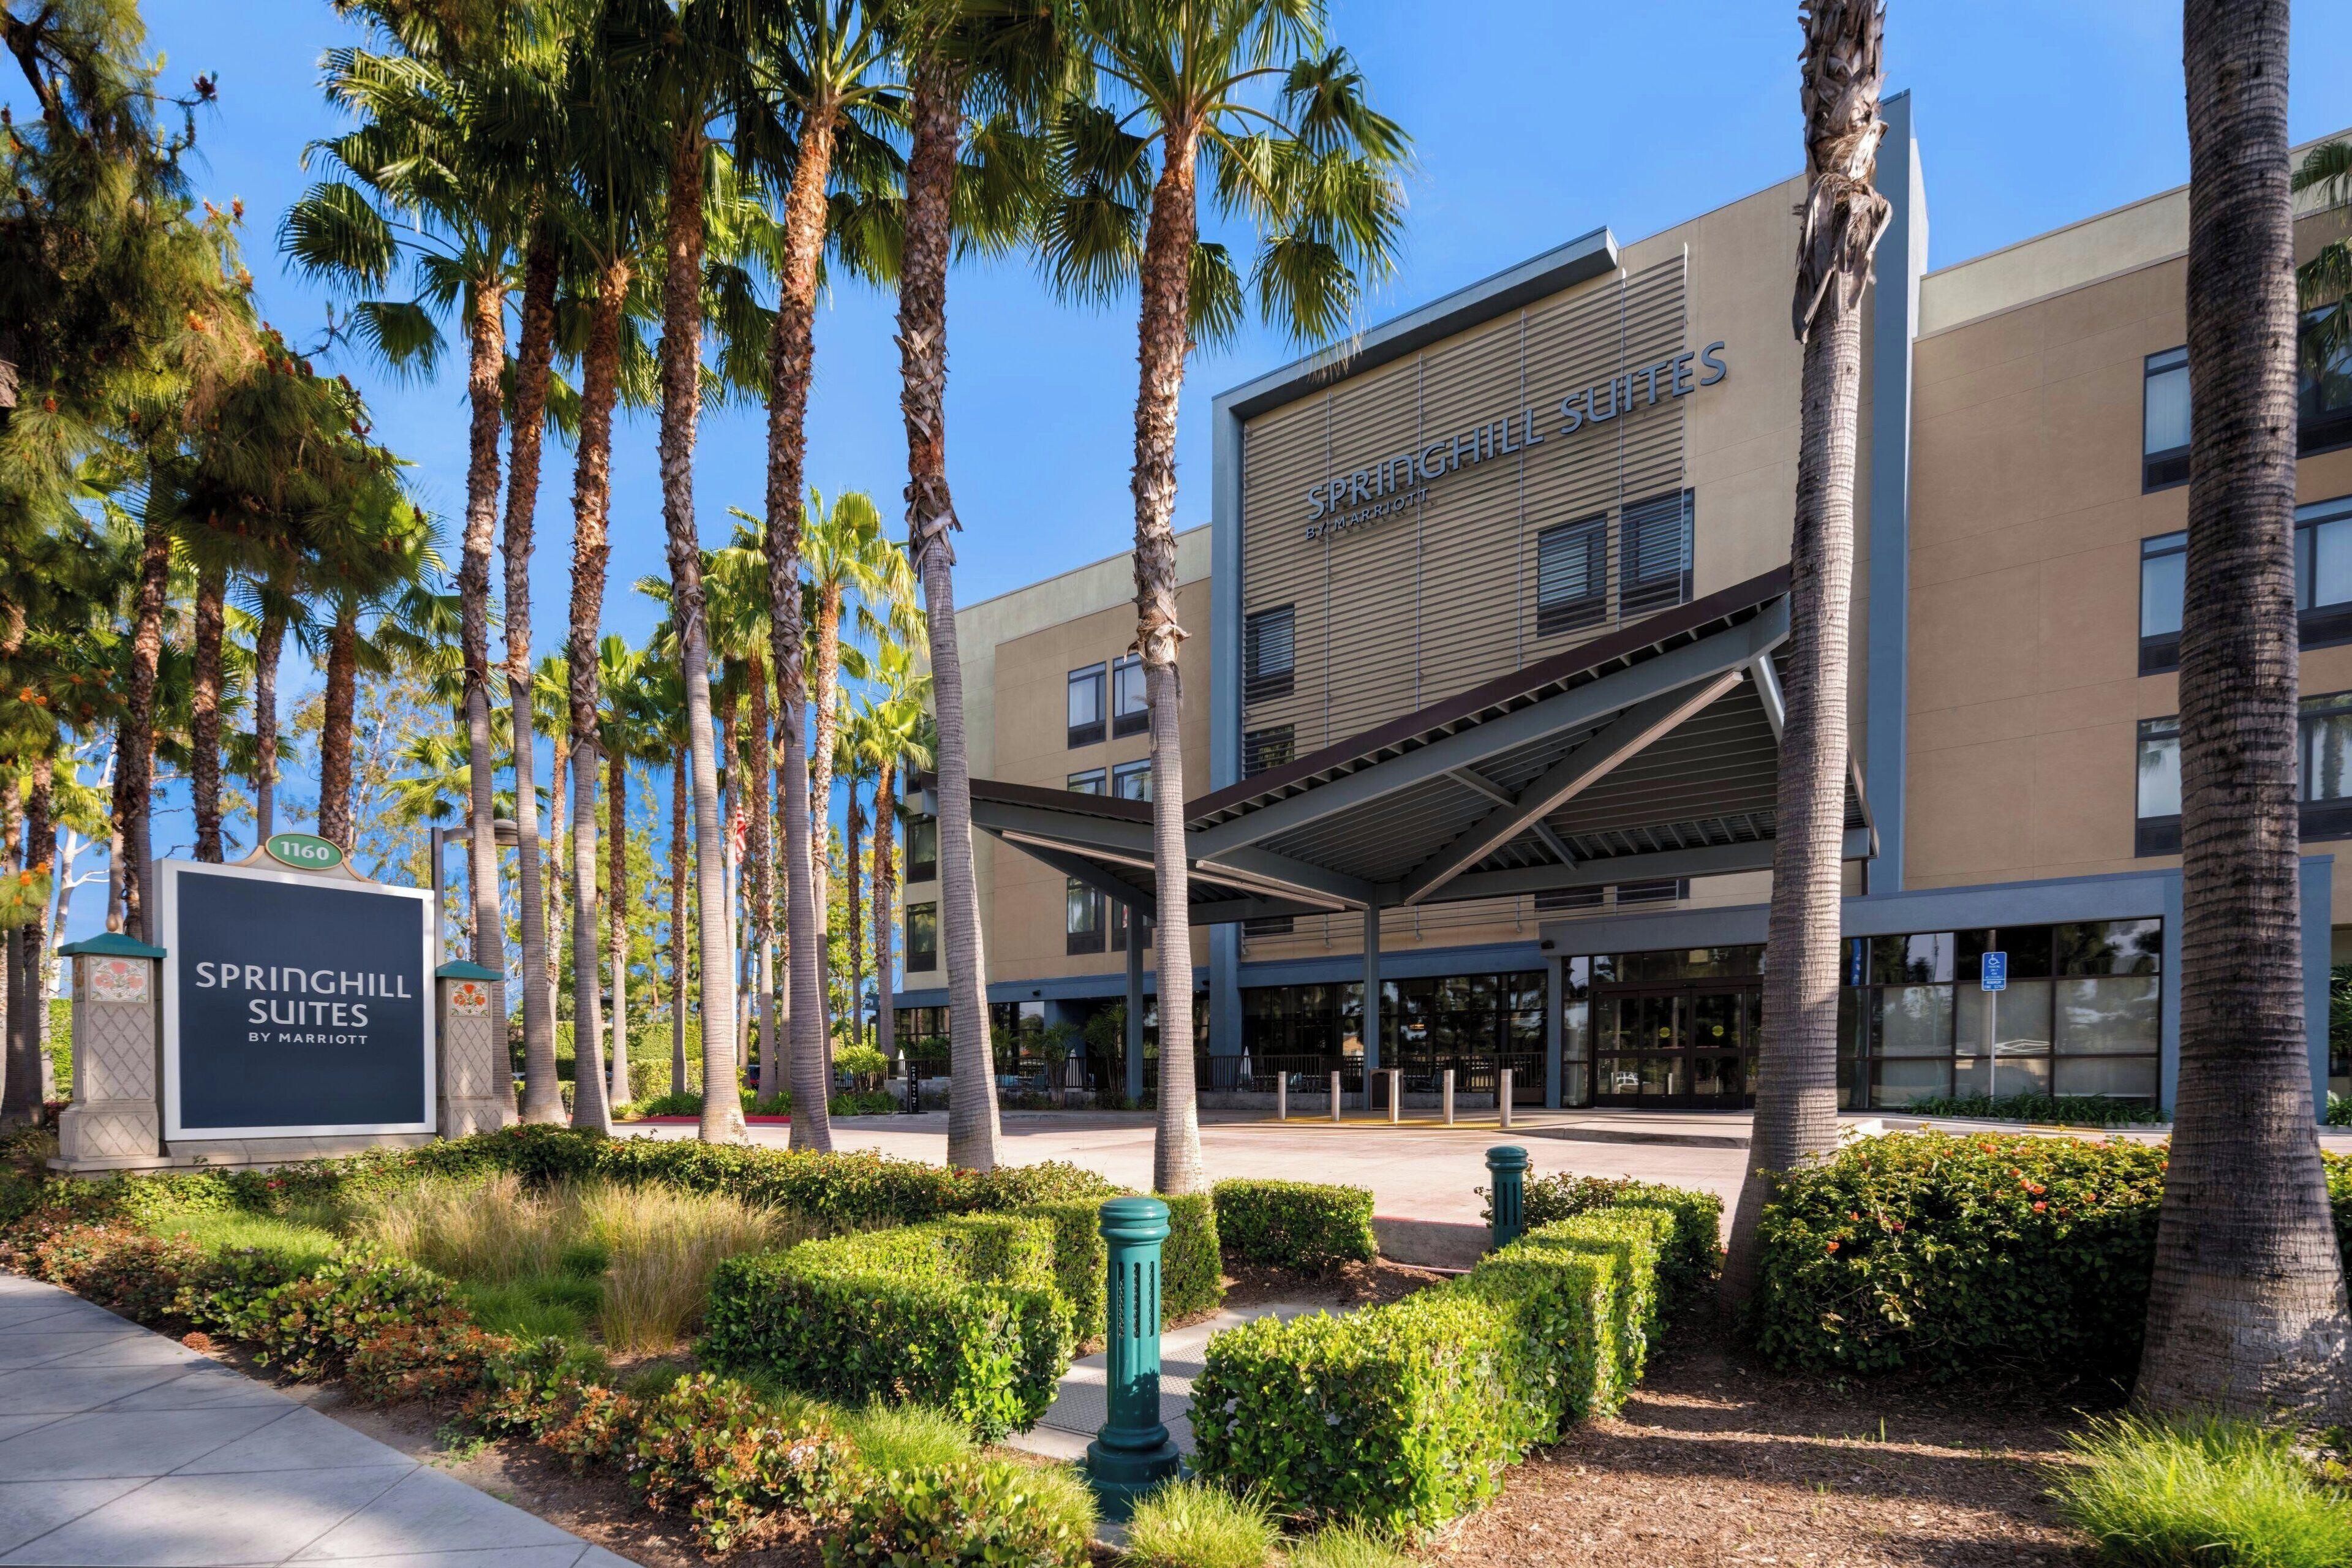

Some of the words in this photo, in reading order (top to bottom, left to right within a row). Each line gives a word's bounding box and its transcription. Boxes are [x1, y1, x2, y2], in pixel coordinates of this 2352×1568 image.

[1307, 409, 1545, 520] SPRINGHILL
[1560, 341, 1727, 434] SUITES
[1305, 522, 1327, 540] BY
[1335, 488, 1430, 531] MARRIOTT
[280, 840, 330, 861] 1160
[195, 962, 412, 998] SPRINGHILL
[248, 999, 368, 1027] SUITES
[249, 1032, 271, 1042] BY
[279, 1033, 368, 1044] MARRIOTT
